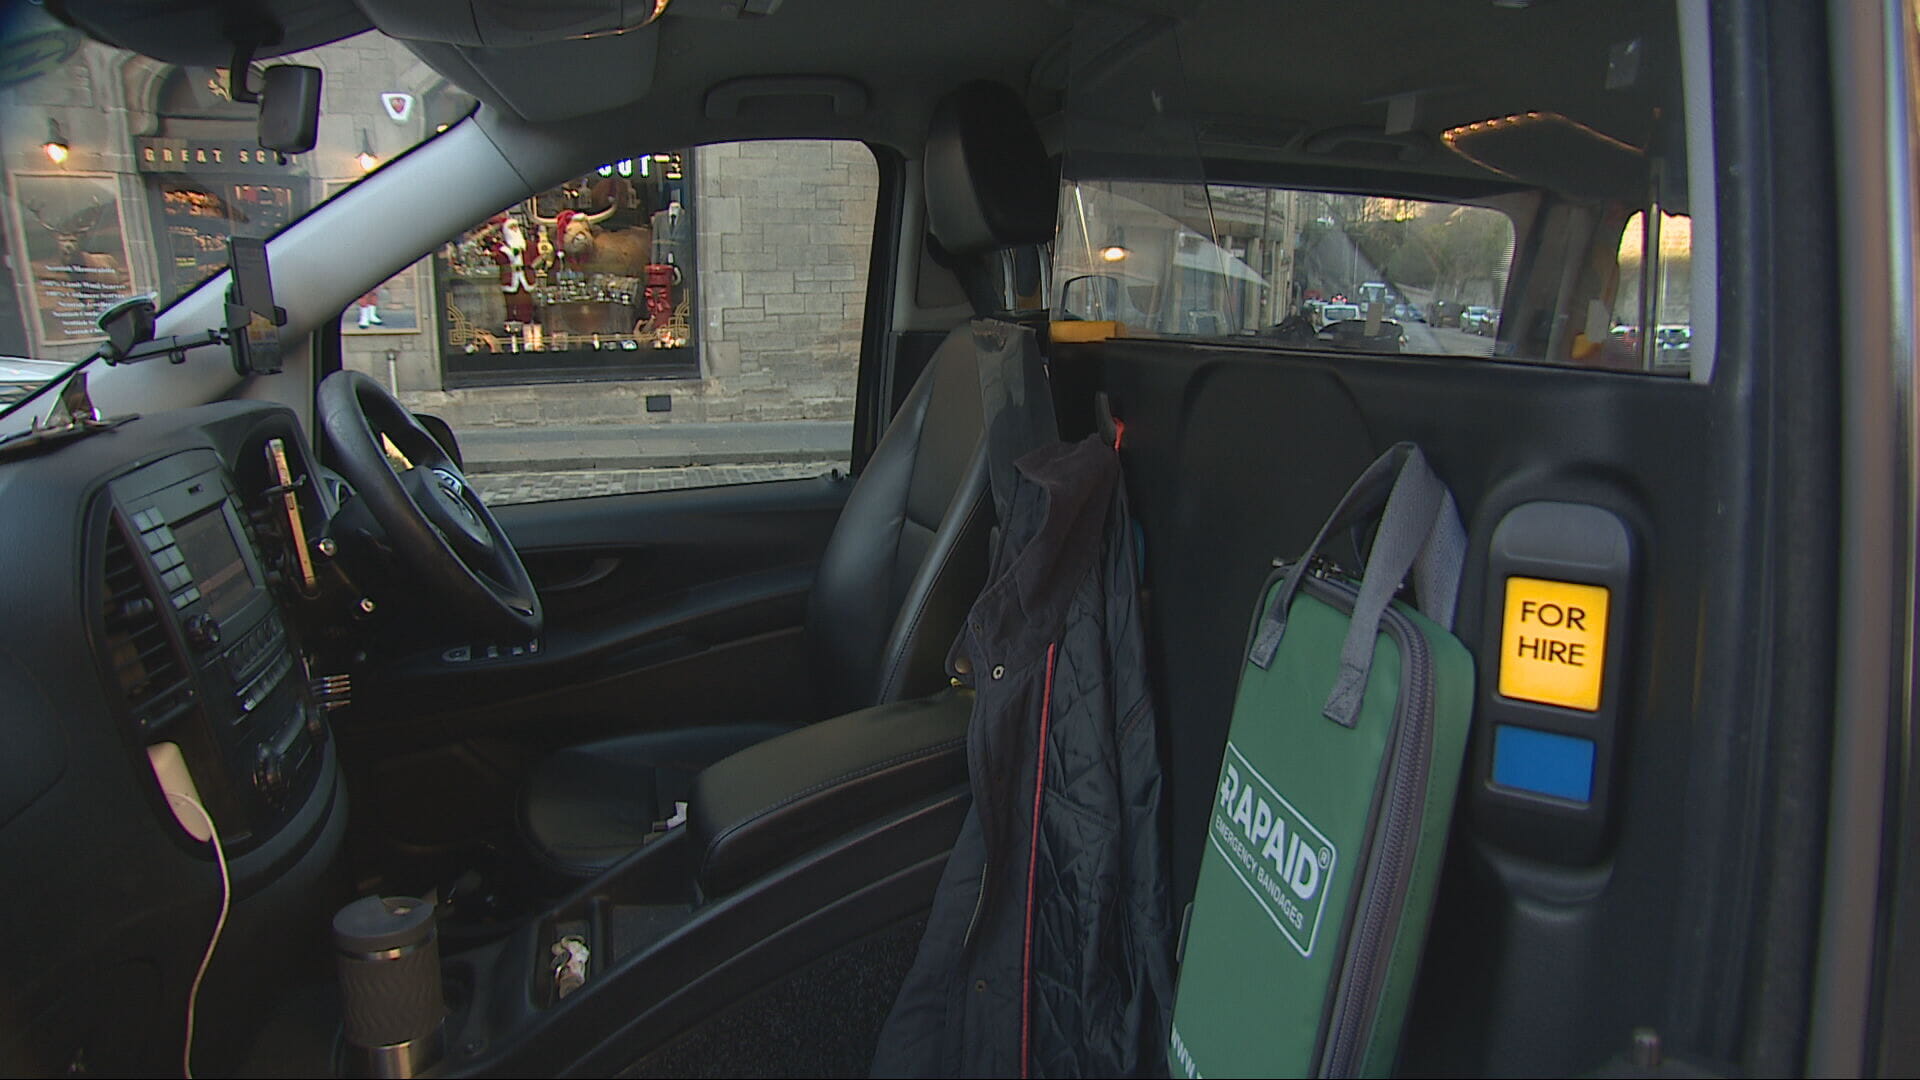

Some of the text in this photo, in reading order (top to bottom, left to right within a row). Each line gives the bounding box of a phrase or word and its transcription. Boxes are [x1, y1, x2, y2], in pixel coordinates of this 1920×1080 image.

[143, 146, 222, 163] GREAT
[1521, 600, 1587, 632] FOR
[1517, 635, 1585, 667] HIRE
[1214, 813, 1258, 875] EMERGENCY
[1256, 867, 1304, 931] BANDAGES
